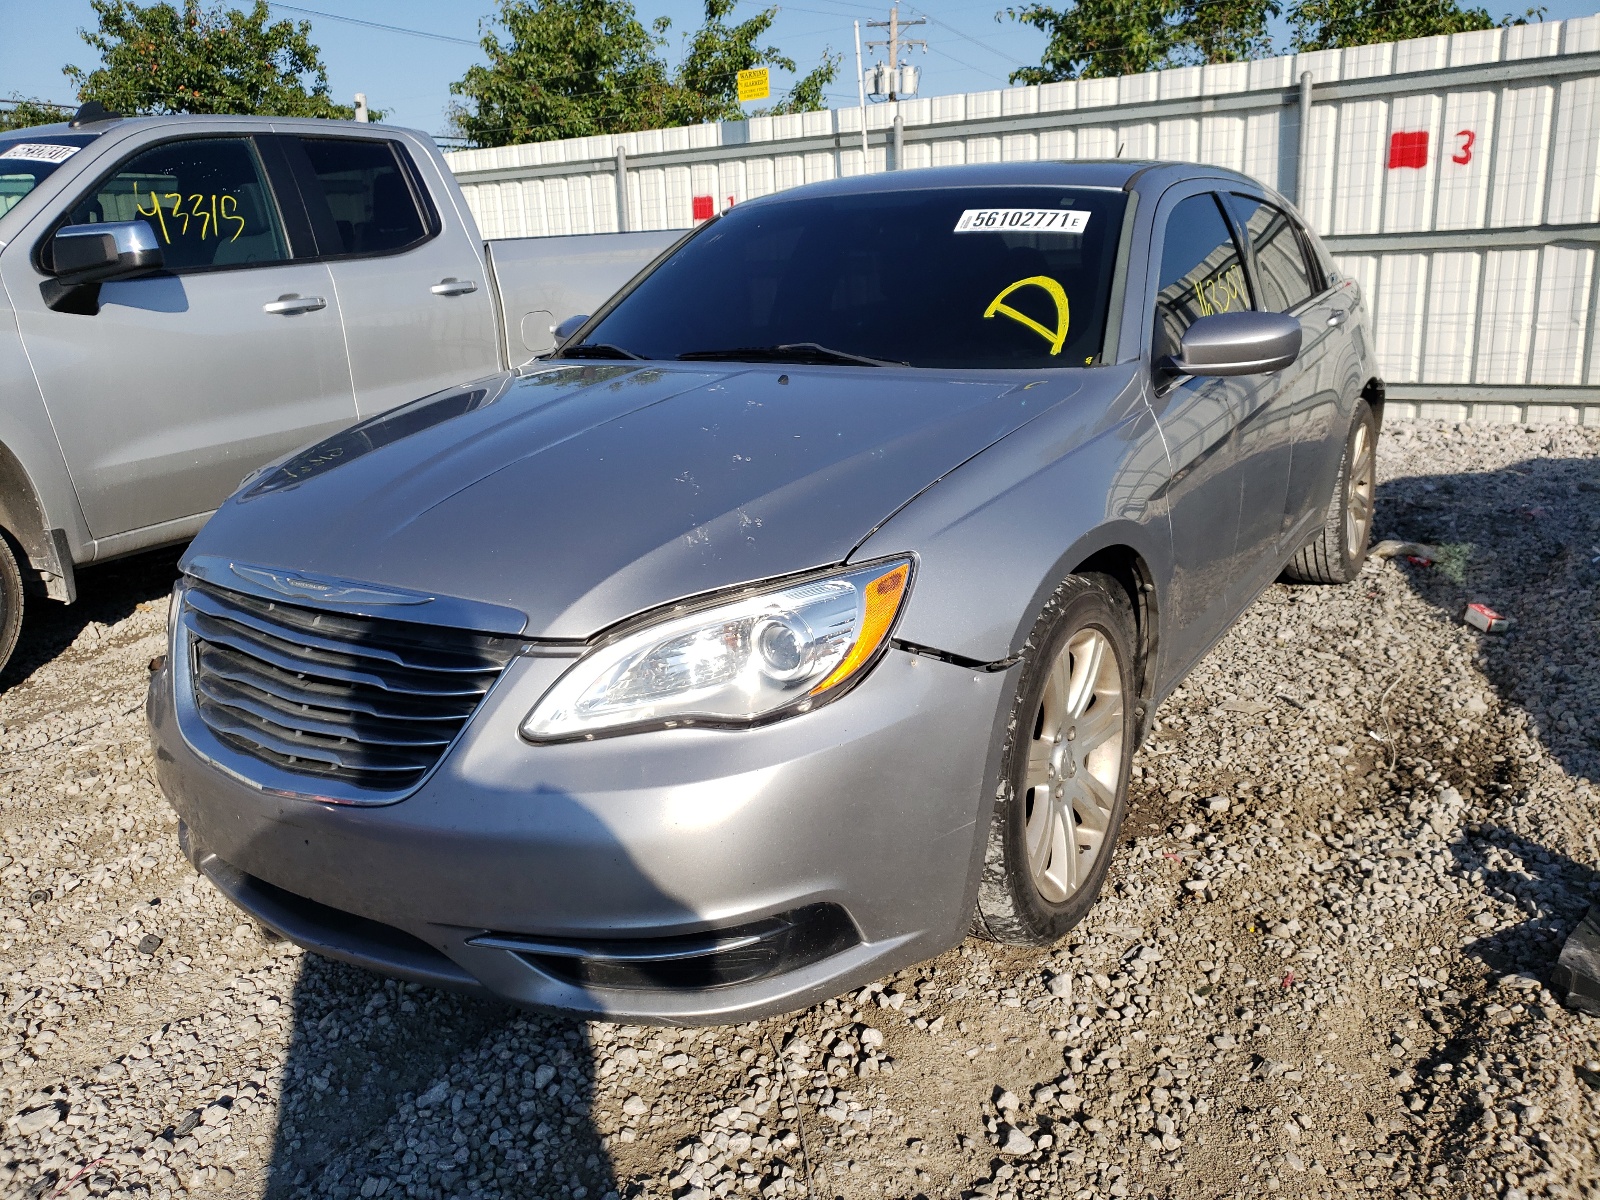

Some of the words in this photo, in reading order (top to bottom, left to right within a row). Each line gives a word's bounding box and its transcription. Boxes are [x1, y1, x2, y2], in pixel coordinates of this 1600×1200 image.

[740, 69, 767, 79] WARNING
[1453, 130, 1475, 165] 3
[972, 211, 1071, 227] 56102771
[1071, 217, 1080, 227] E
